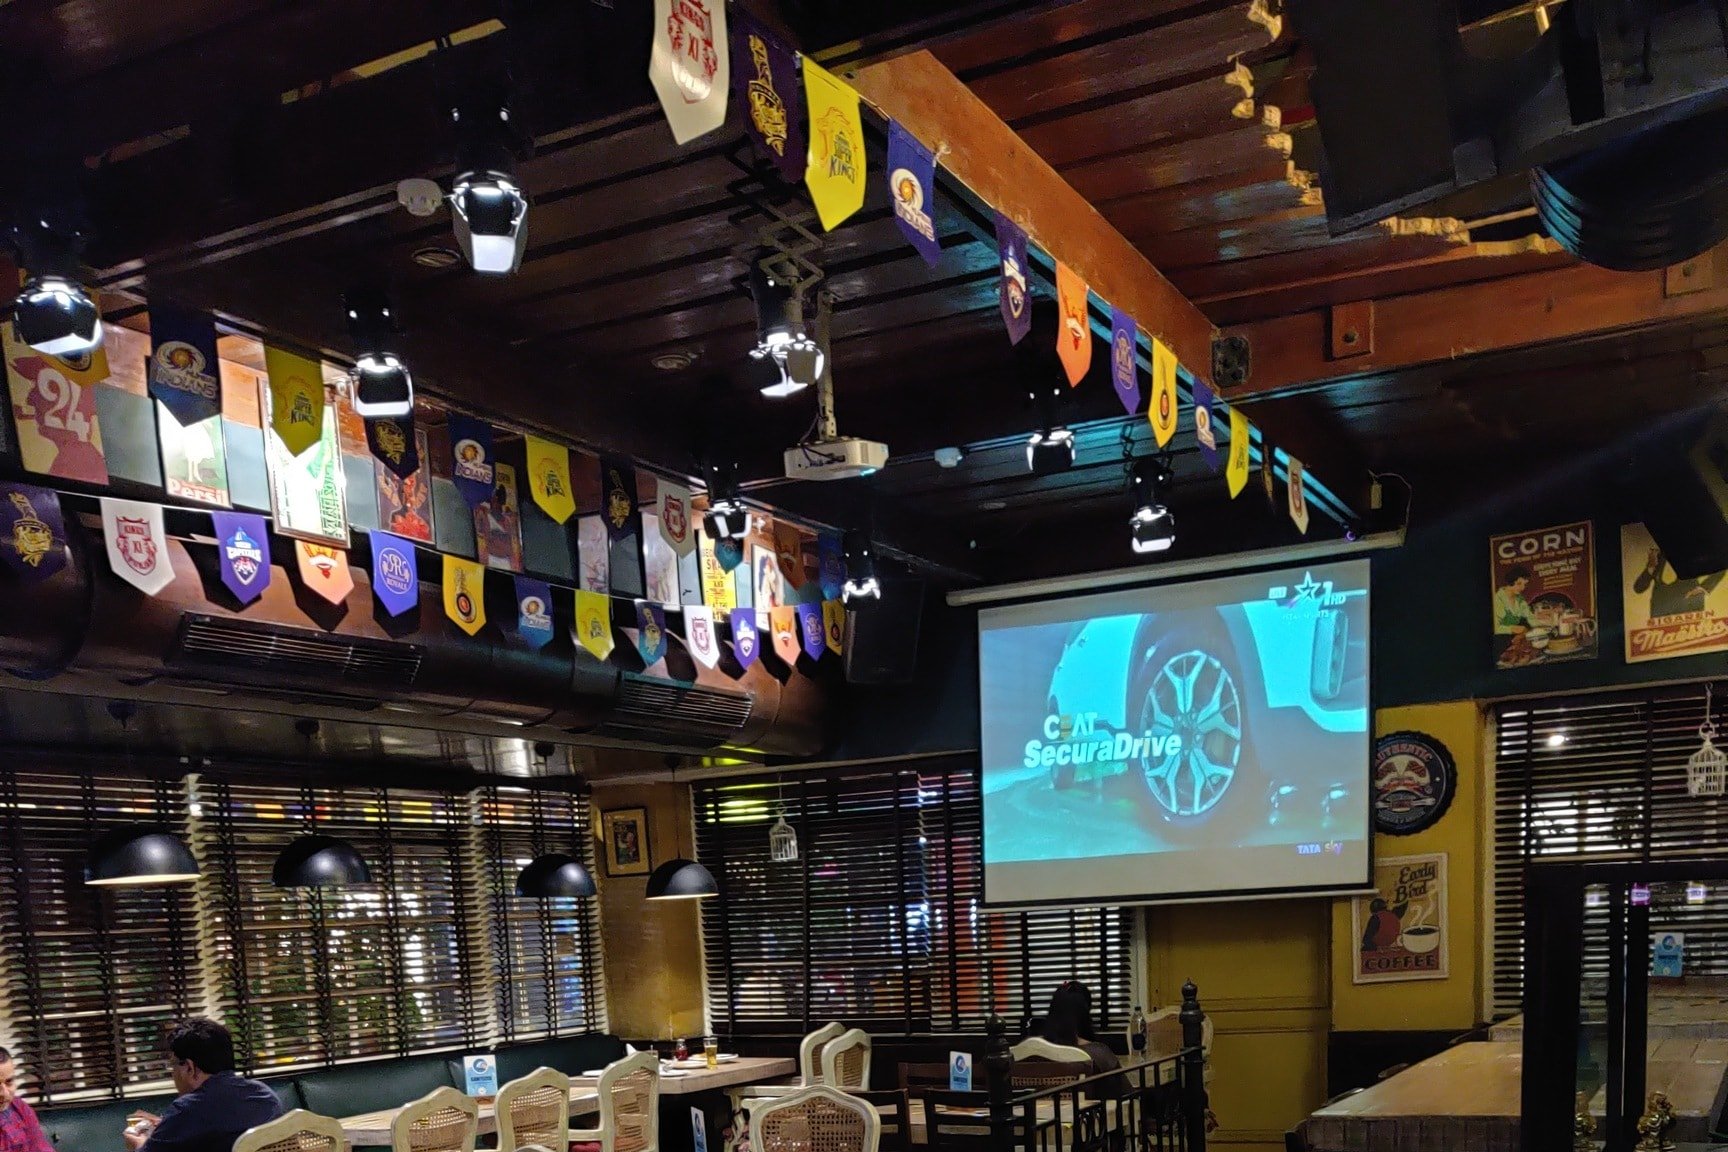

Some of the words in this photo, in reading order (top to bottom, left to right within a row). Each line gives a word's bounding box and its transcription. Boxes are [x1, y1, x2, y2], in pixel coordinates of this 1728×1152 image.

[168, 477, 230, 505] Persil
[1498, 528, 1585, 559] CORN
[1023, 729, 1182, 769] SecuraDrive
[1295, 843, 1321, 855] TATA
[1399, 862, 1436, 885] Early
[1395, 880, 1428, 903] Bird
[1364, 954, 1435, 971] COFFEE
